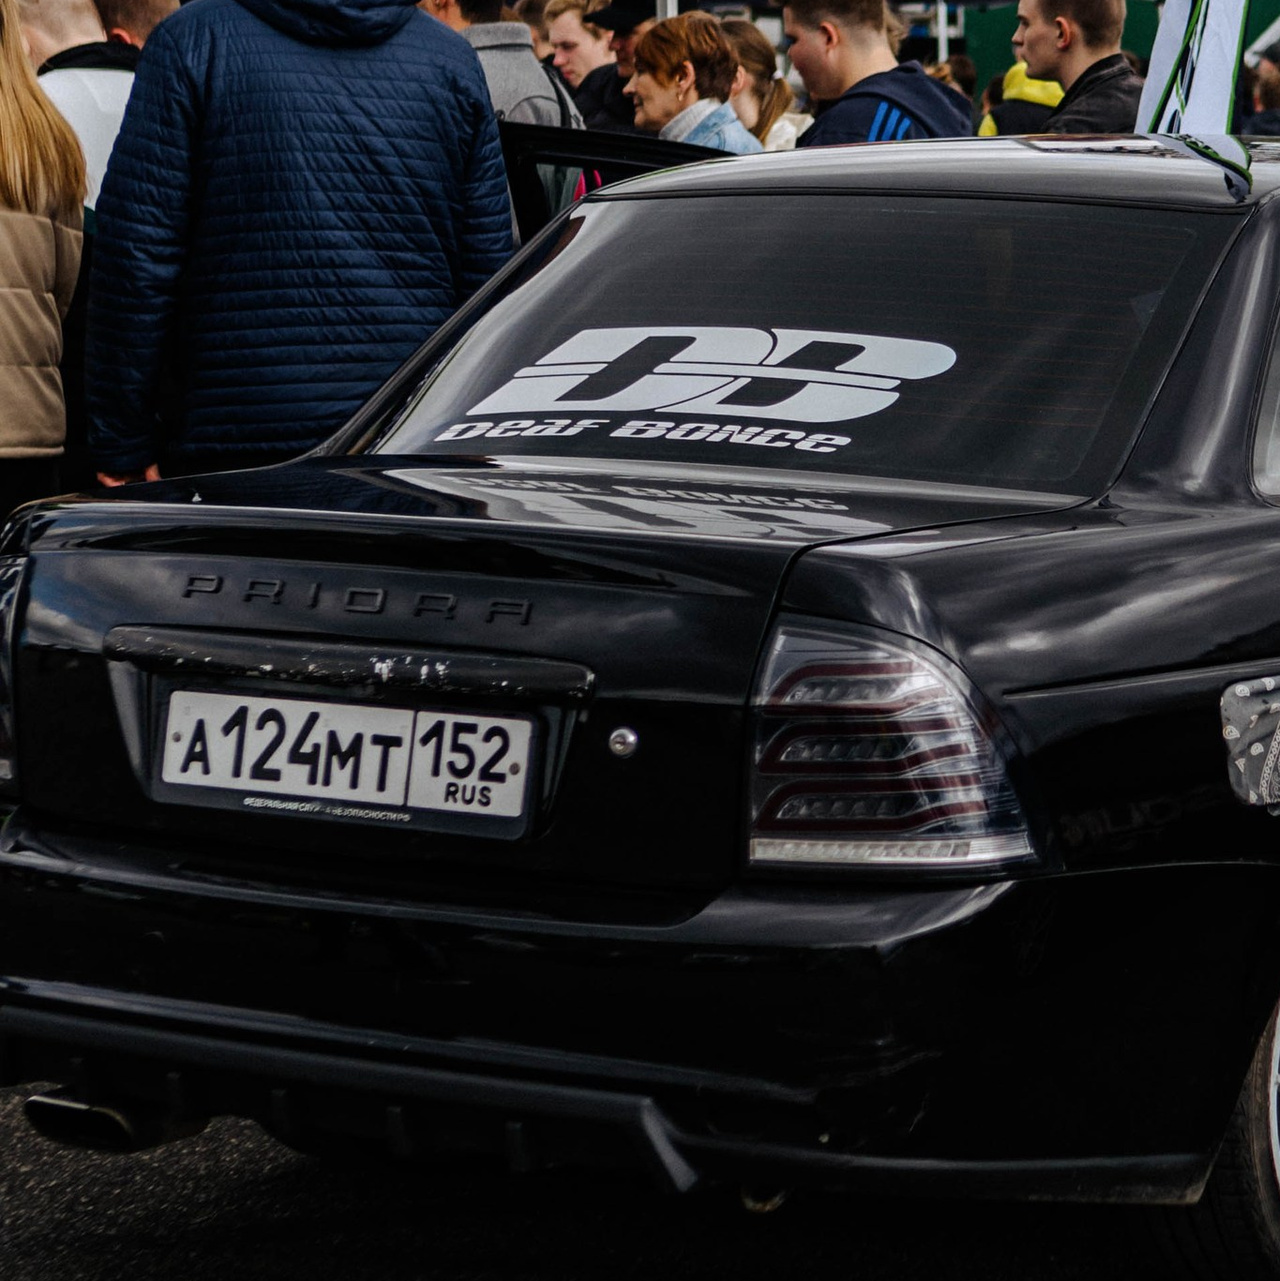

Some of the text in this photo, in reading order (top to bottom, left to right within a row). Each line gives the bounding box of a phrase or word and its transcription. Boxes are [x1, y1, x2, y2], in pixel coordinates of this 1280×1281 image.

[182, 574, 533, 626] PRIORA
[418, 720, 511, 783] 152
[444, 782, 493, 807] RUS
